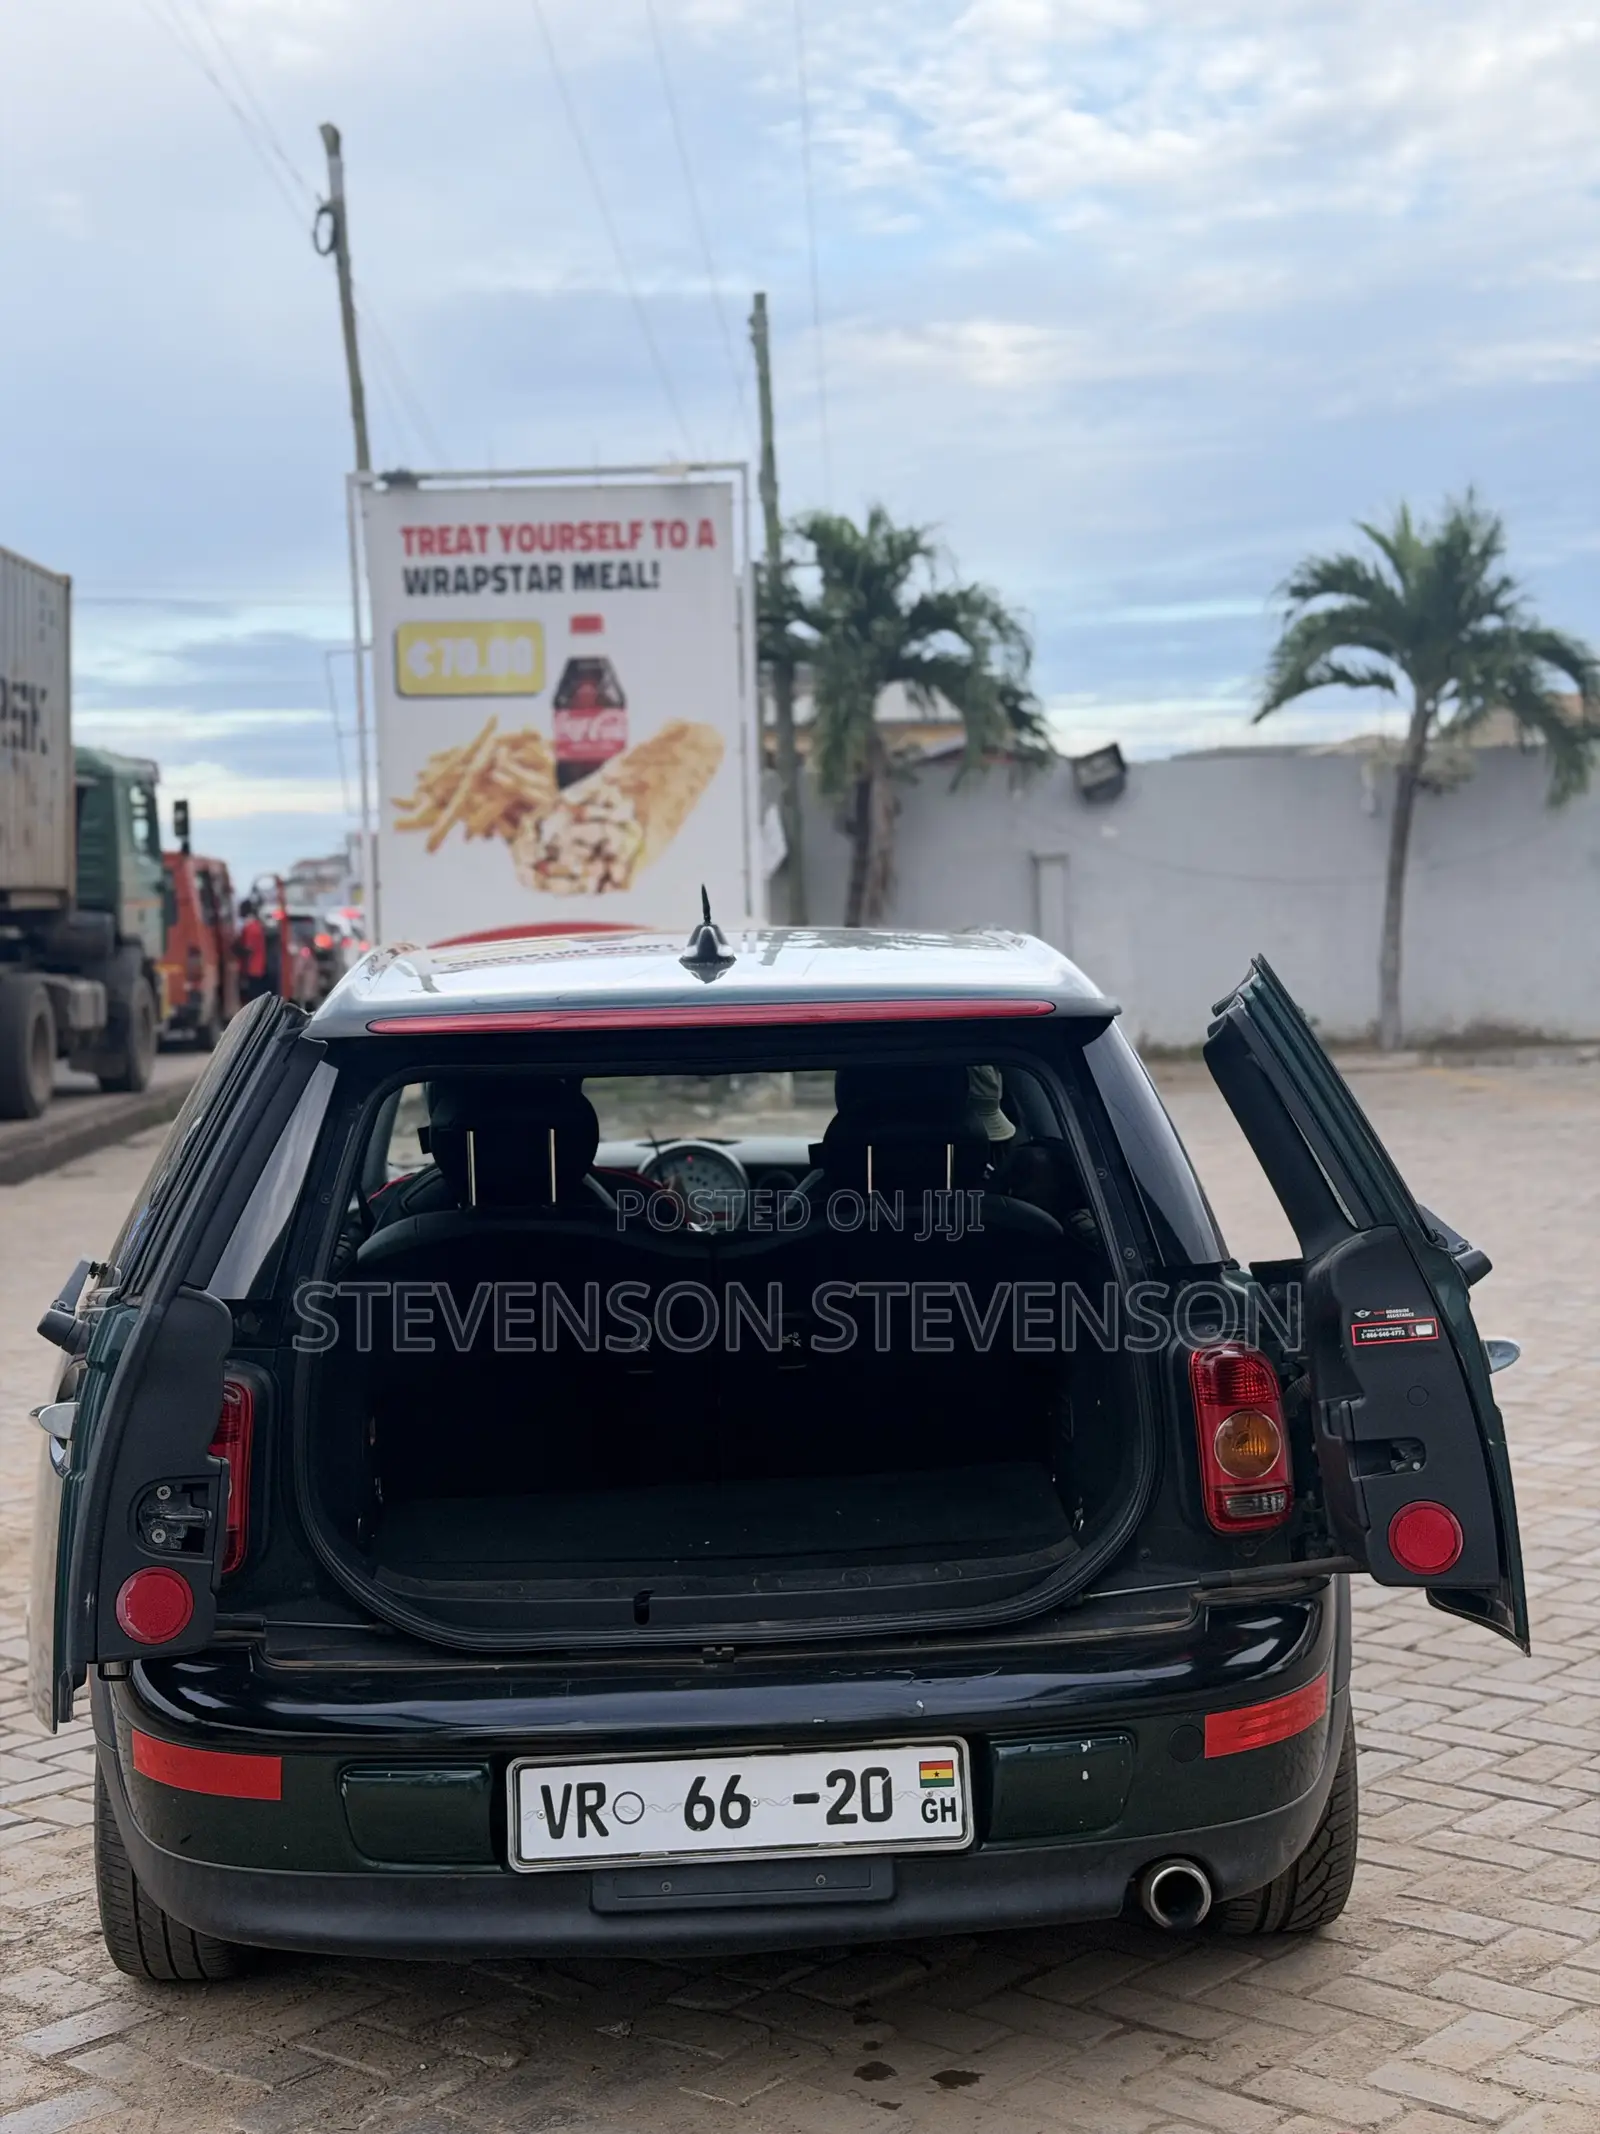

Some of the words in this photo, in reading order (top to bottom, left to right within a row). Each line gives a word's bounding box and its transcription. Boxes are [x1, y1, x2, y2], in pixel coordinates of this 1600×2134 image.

[401, 525, 489, 556] TREAT
[497, 521, 644, 553] YOURSELF
[650, 521, 688, 549] TO
[696, 518, 716, 549] A
[403, 562, 565, 596] WRAPSTAR
[572, 560, 660, 591] MEAL!
[540, 1782, 609, 1839] VR
[684, 1774, 751, 1831] 66
[921, 1797, 957, 1824] GH
